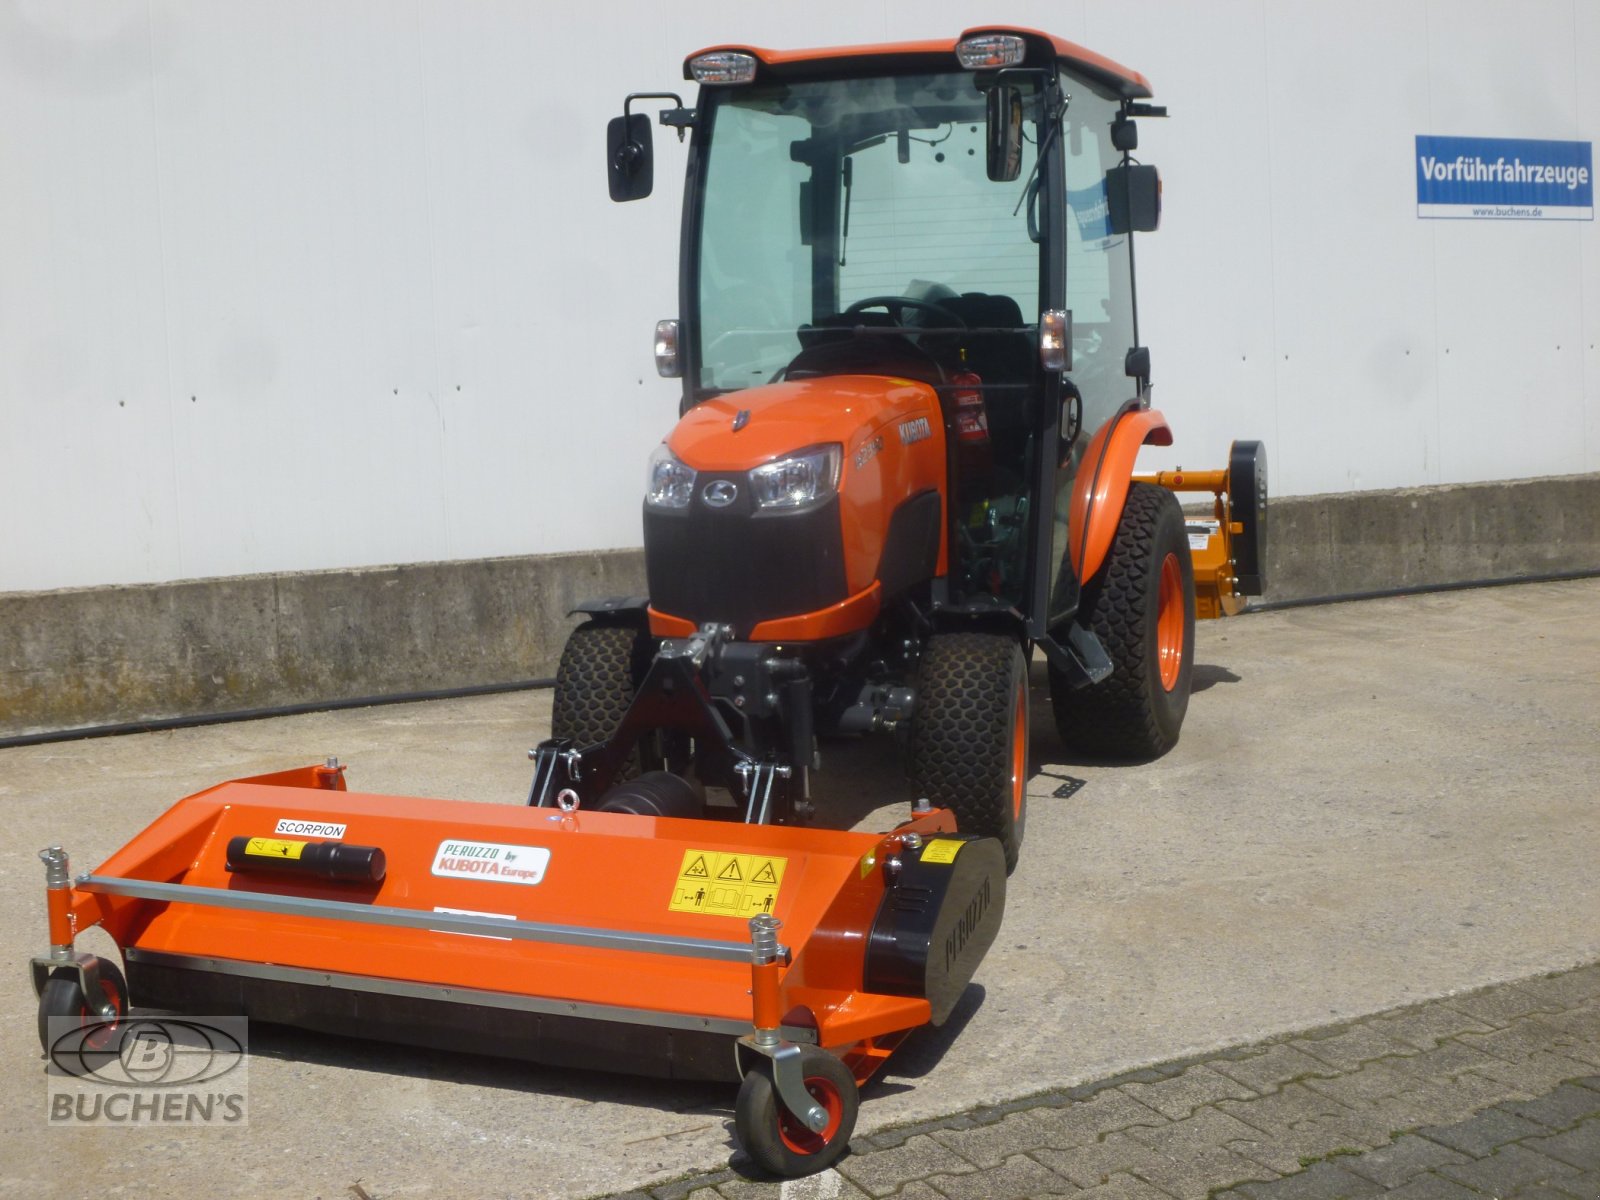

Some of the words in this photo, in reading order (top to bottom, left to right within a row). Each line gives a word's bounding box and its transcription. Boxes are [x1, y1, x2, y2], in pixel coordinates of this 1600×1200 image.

[1420, 156, 1589, 190] Vorführfahrzeuge
[1472, 205, 1543, 217] www.buchens.de
[898, 417, 932, 444] KUBOTA
[277, 821, 345, 837] SCORPION
[443, 844, 500, 859] PERUZZO
[504, 850, 518, 863] by
[438, 857, 499, 875] KUBOTA
[501, 866, 538, 880] Europe
